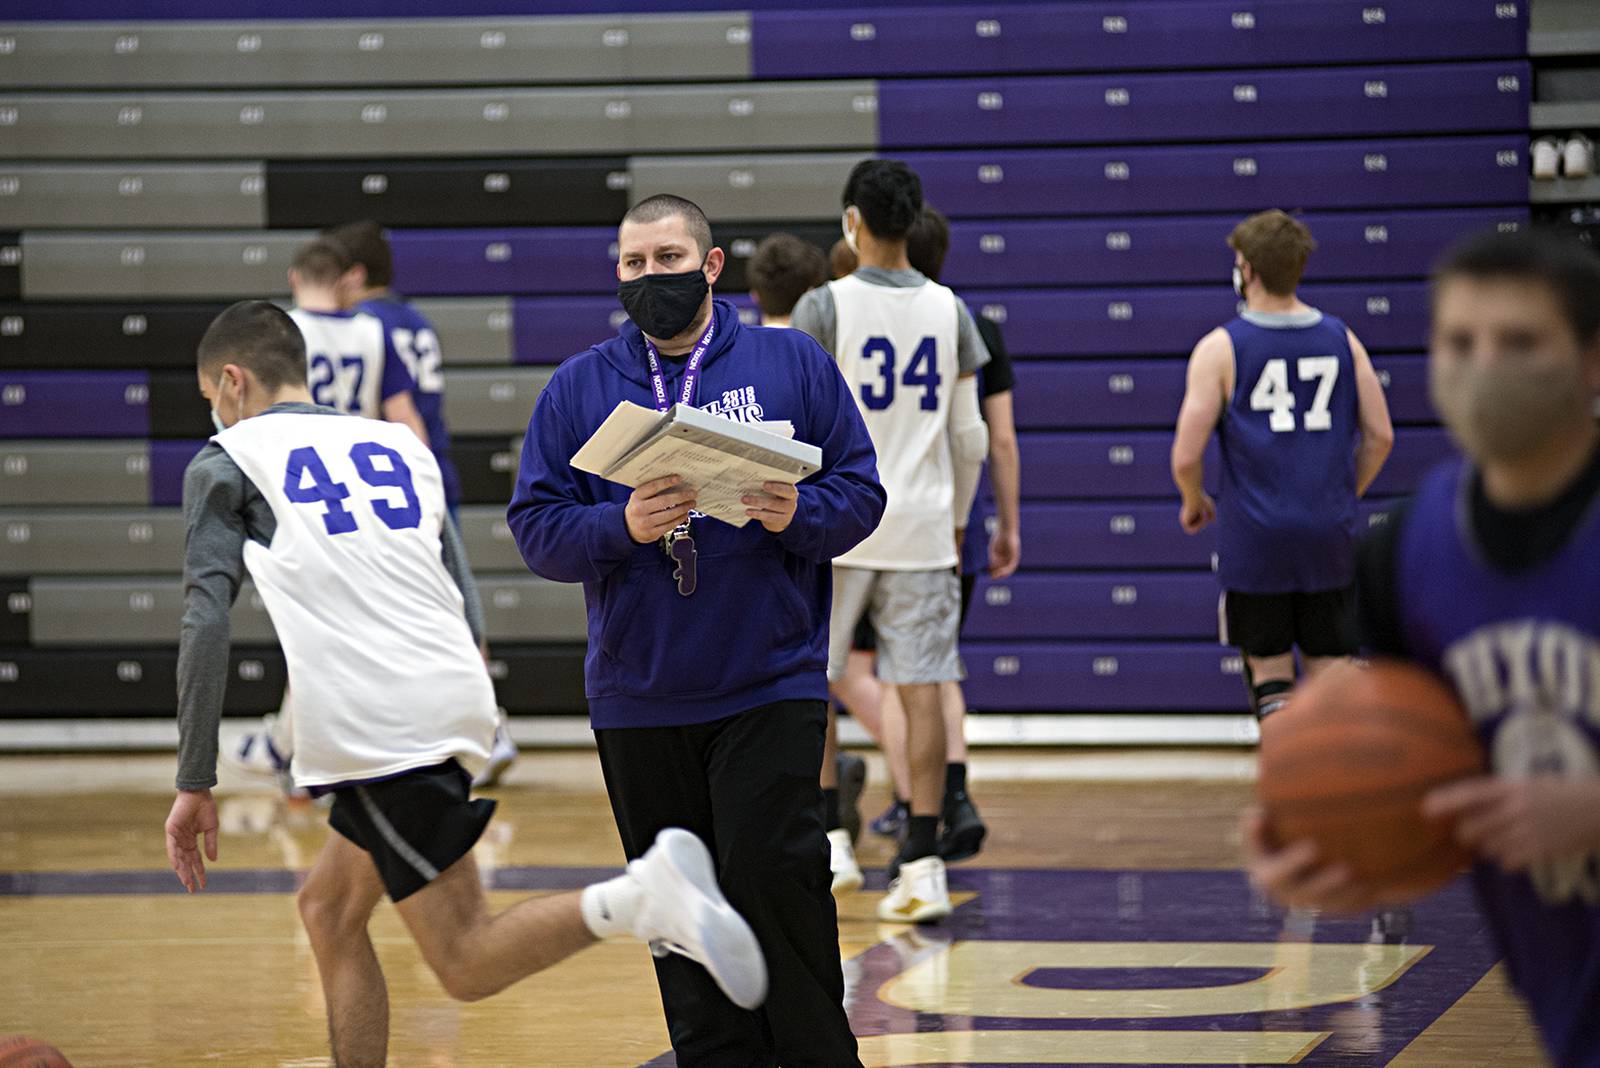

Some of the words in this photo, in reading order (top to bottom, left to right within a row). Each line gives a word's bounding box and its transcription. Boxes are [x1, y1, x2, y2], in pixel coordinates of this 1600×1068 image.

[310, 354, 364, 411] 27
[861, 336, 942, 411] 34
[1249, 355, 1339, 432] 47
[283, 441, 422, 535] 49
